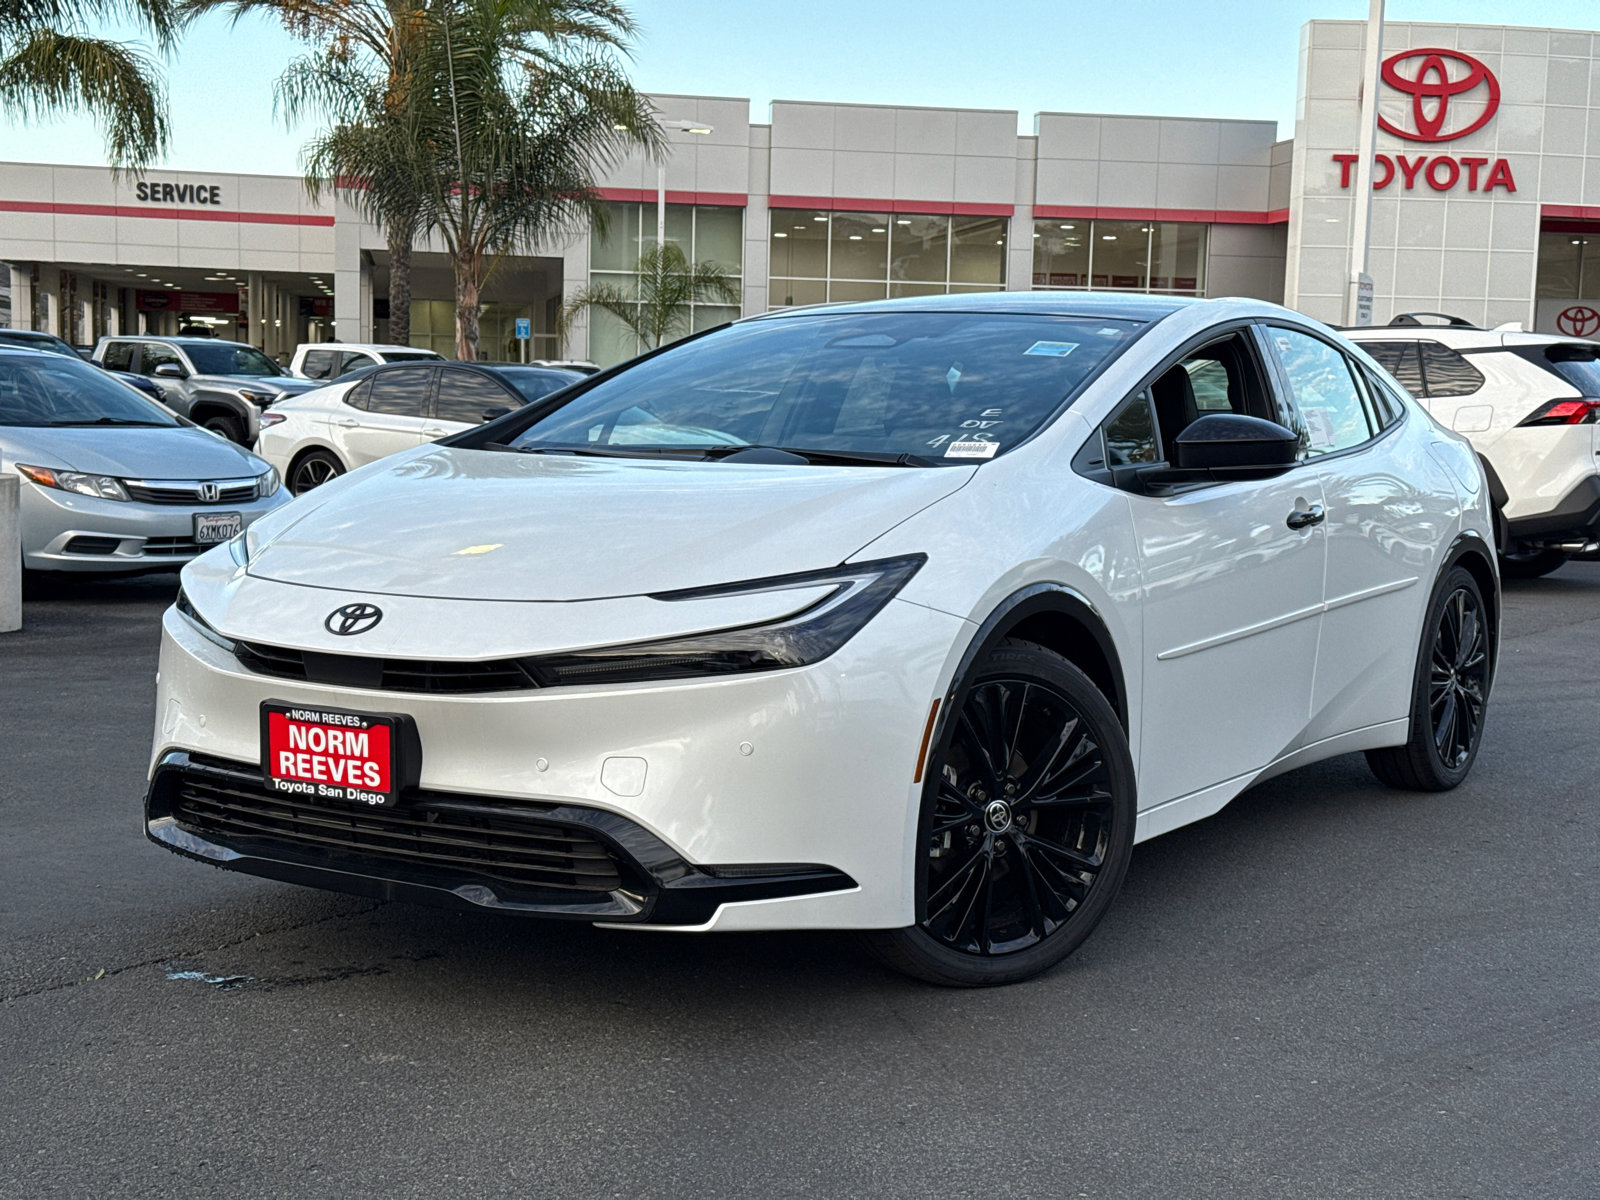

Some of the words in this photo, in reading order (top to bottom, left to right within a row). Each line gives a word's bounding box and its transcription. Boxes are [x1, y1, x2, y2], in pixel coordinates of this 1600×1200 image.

[1332, 154, 1517, 193] TOYOTA
[136, 182, 221, 204] SERVICE
[199, 524, 239, 539] 6XMK076
[291, 709, 320, 722] NORM
[322, 713, 360, 727] REEVES
[288, 724, 369, 758] NORM
[279, 750, 381, 787] REEVES
[272, 778, 315, 794] Toyota
[318, 784, 343, 798] San
[346, 788, 385, 805] Diego
